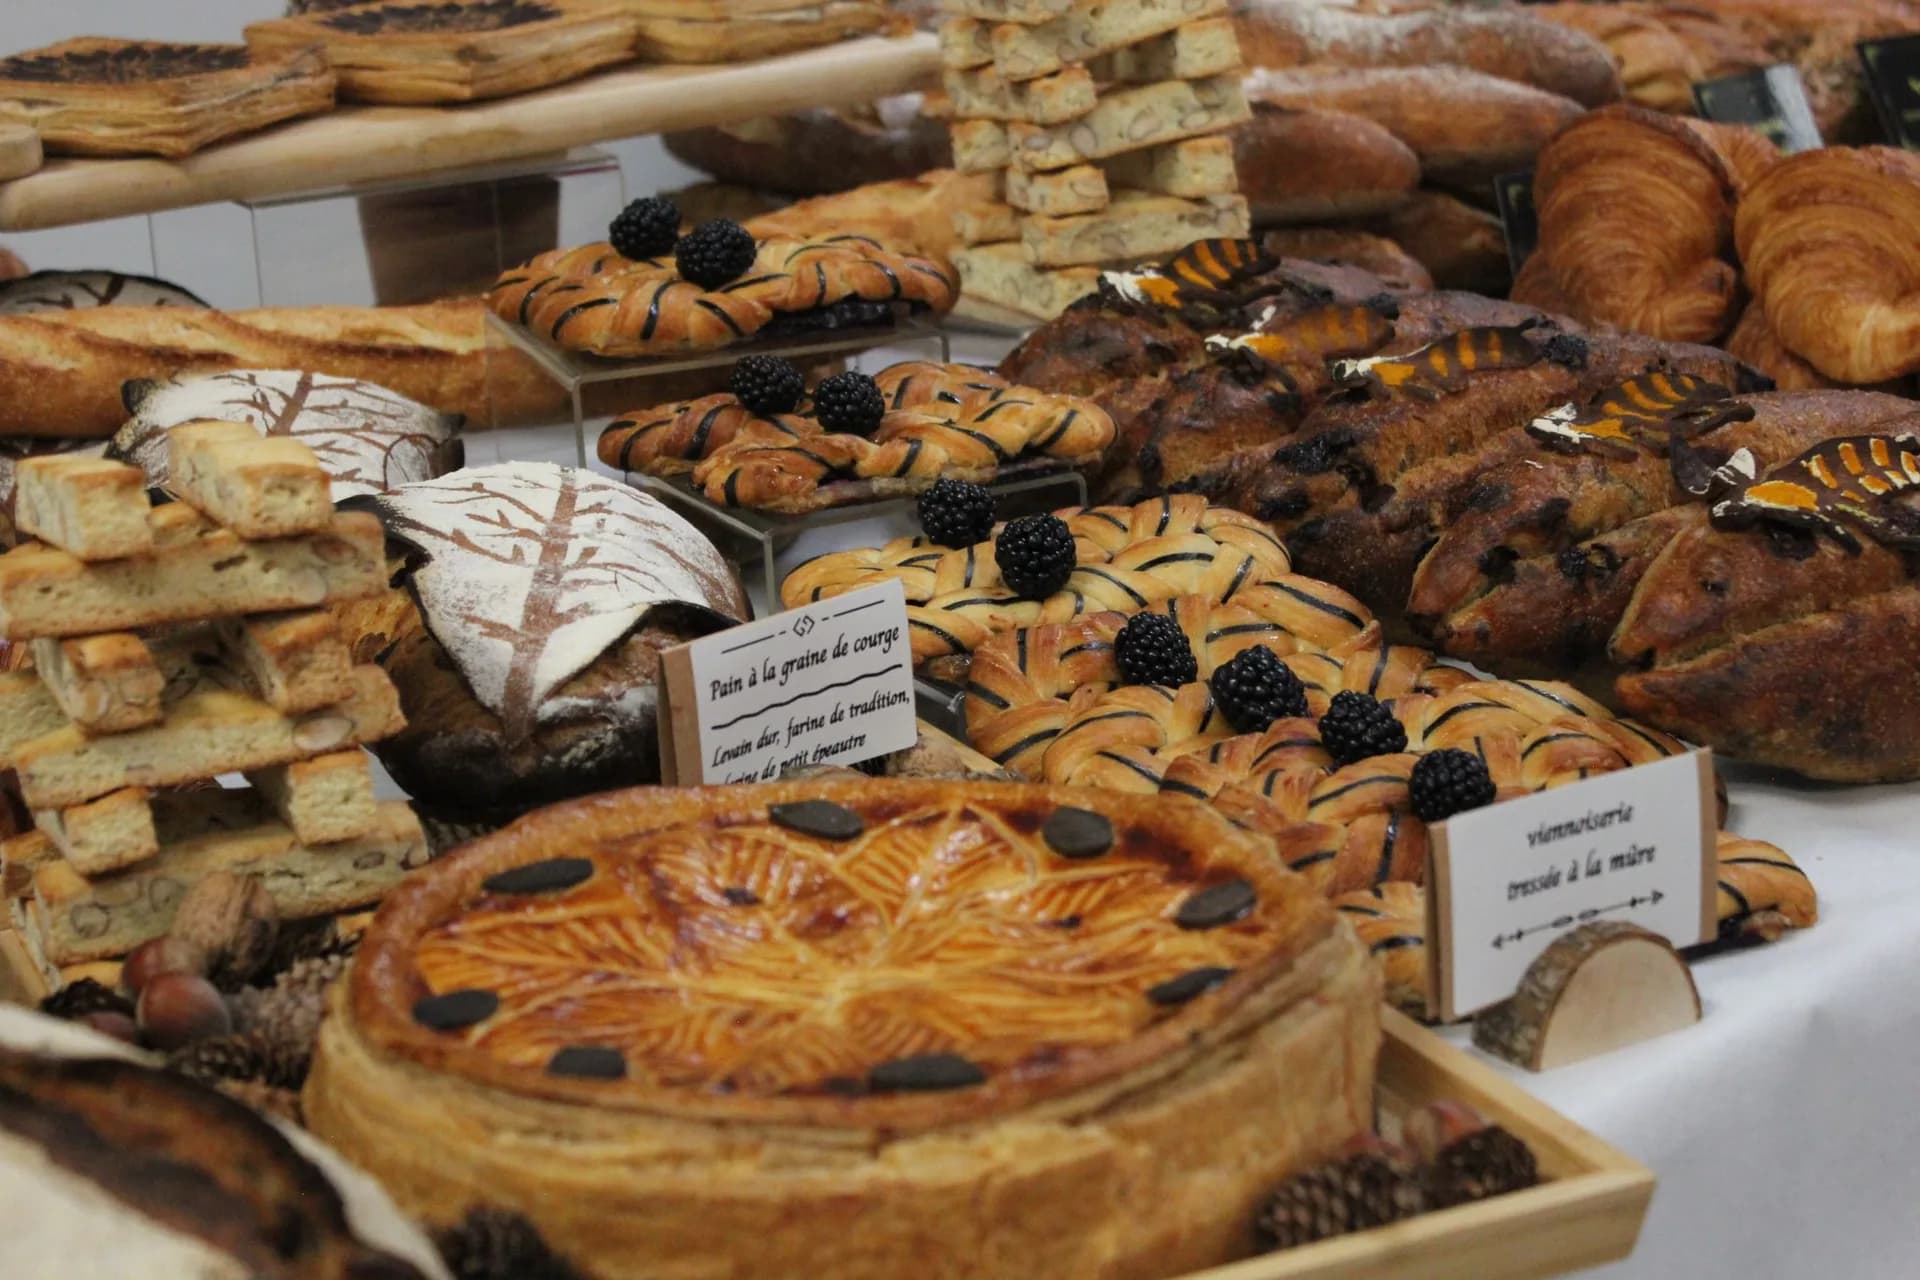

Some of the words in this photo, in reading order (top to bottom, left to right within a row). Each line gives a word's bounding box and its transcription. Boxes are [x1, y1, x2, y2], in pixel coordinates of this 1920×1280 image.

[709, 676, 743, 701] Pain
[748, 667, 758, 688] à
[763, 657, 777, 683] la
[779, 647, 828, 687] graine
[833, 632, 849, 659] de
[853, 625, 901, 655] courge
[711, 742, 753, 769] Levain
[756, 726, 781, 751] dur,
[785, 713, 826, 749] farine
[830, 704, 846, 726] de
[850, 688, 911, 718] tradition,
[762, 756, 777, 781] de
[812, 734, 867, 765] épeautre
[1526, 802, 1634, 848] viennoiserie
[1507, 866, 1562, 901] tressée
[1567, 860, 1580, 884] à
[1585, 848, 1603, 878] la
[1609, 844, 1657, 872] mûre
